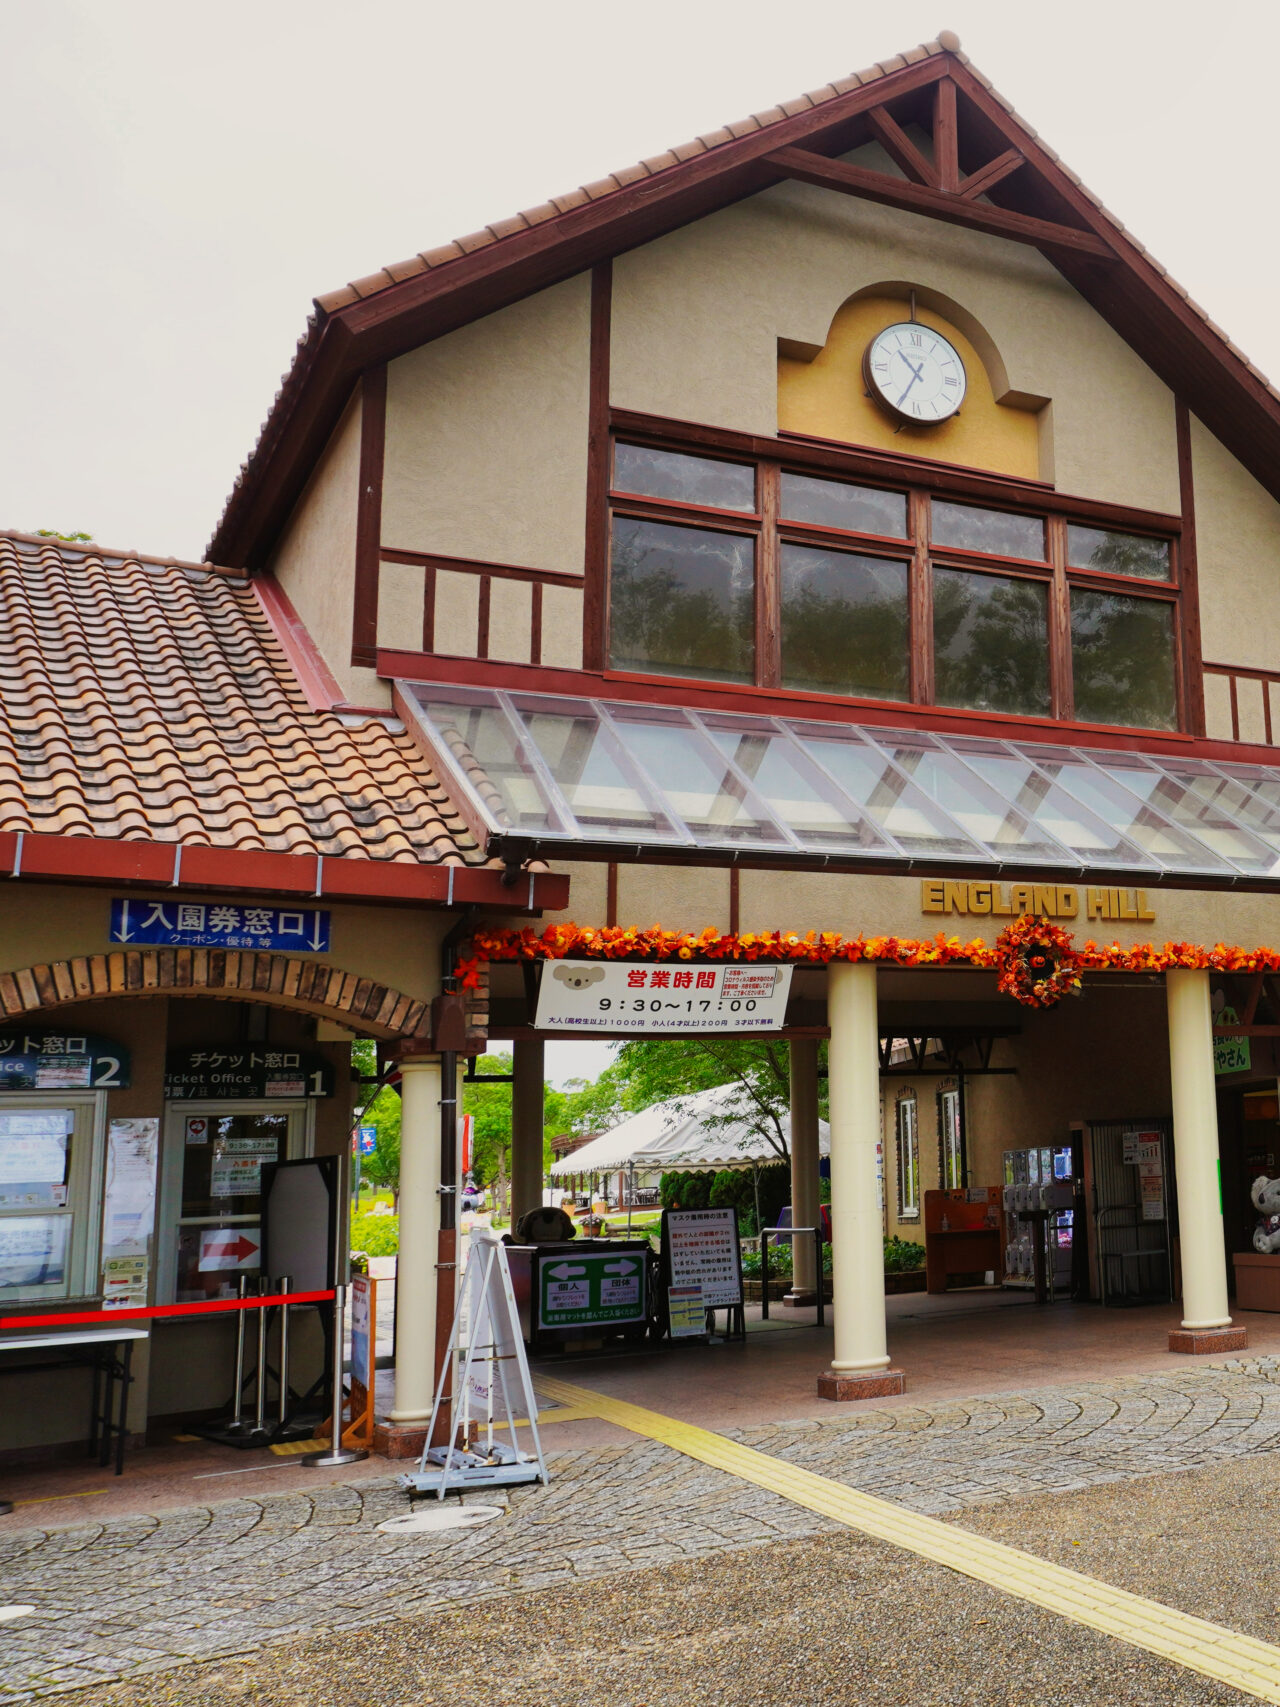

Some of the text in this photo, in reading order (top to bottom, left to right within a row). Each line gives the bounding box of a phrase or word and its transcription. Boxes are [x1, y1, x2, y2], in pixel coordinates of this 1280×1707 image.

[921, 880, 1156, 920] ENGLAND HILL
[140, 902, 304, 935] 入園券窓口
[169, 933, 254, 947] クーポン・優待
[627, 969, 716, 989] 営業時間
[190, 1052, 300, 1068] チケット窓口
[1214, 1047, 1246, 1070] やさん
[94, 1056, 121, 1087] 2
[210, 1073, 251, 1084] Office
[308, 1070, 328, 1096] 1
[558, 1283, 579, 1291] 個人
[611, 1279, 631, 1287] 団体
